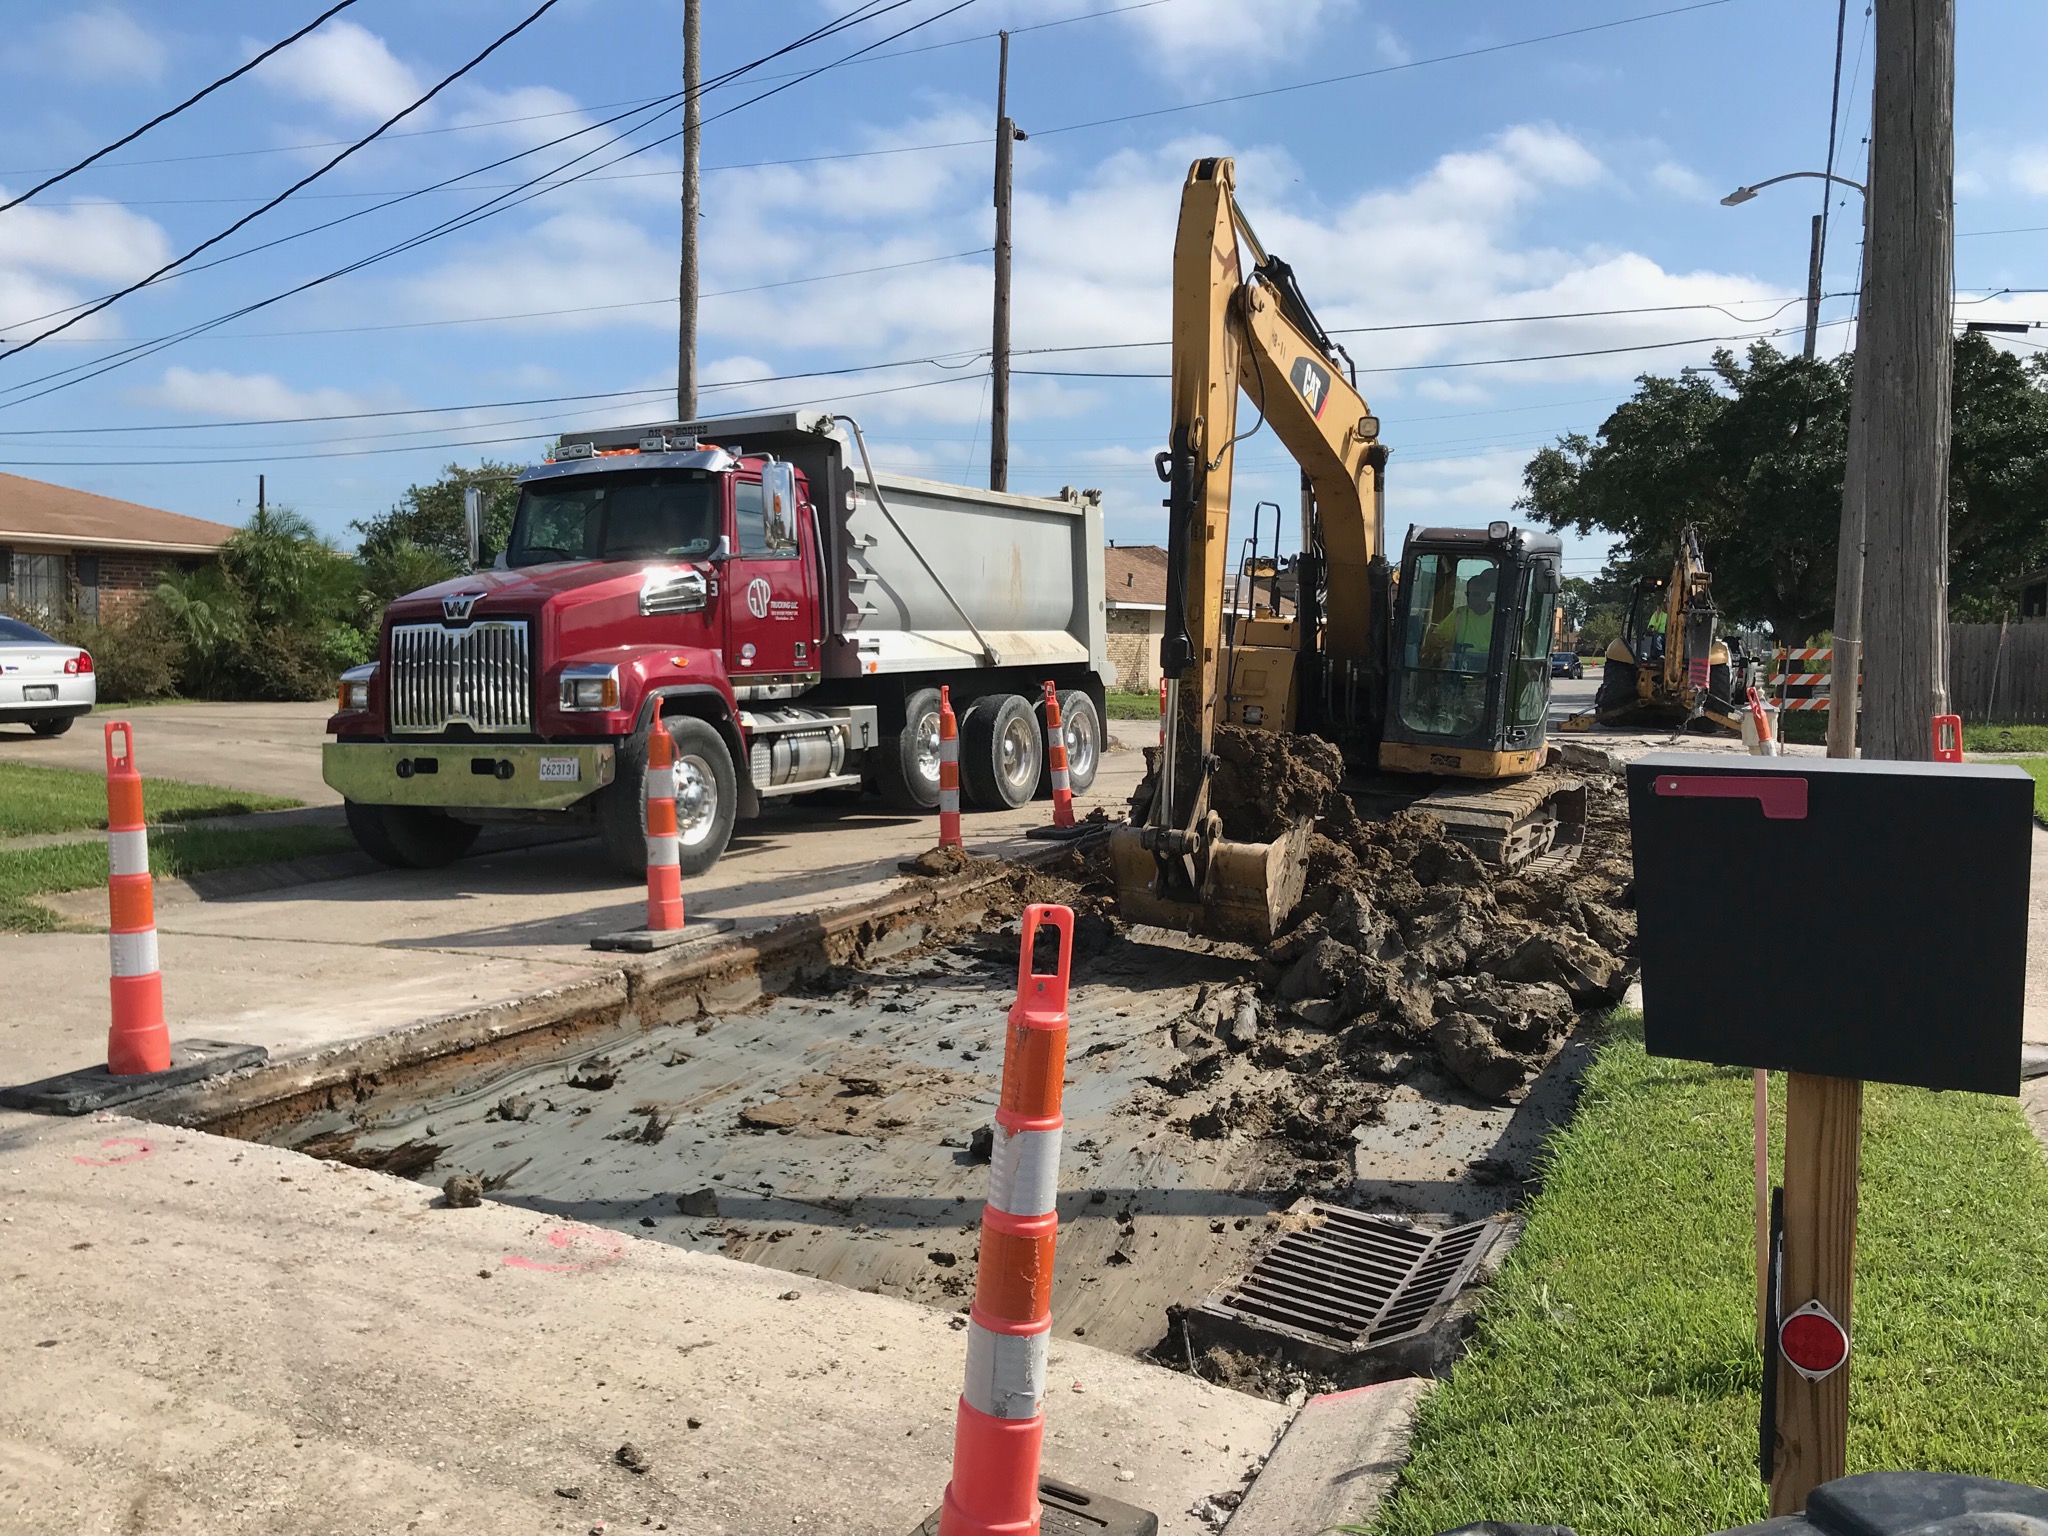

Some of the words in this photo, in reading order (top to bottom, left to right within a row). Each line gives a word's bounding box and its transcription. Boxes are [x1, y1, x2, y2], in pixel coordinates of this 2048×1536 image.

[1302, 363, 1321, 412] CAT
[676, 426, 708, 435] BODIES
[709, 581, 719, 597] 3
[747, 578, 771, 618] GSP
[541, 763, 576, 776] C623131
